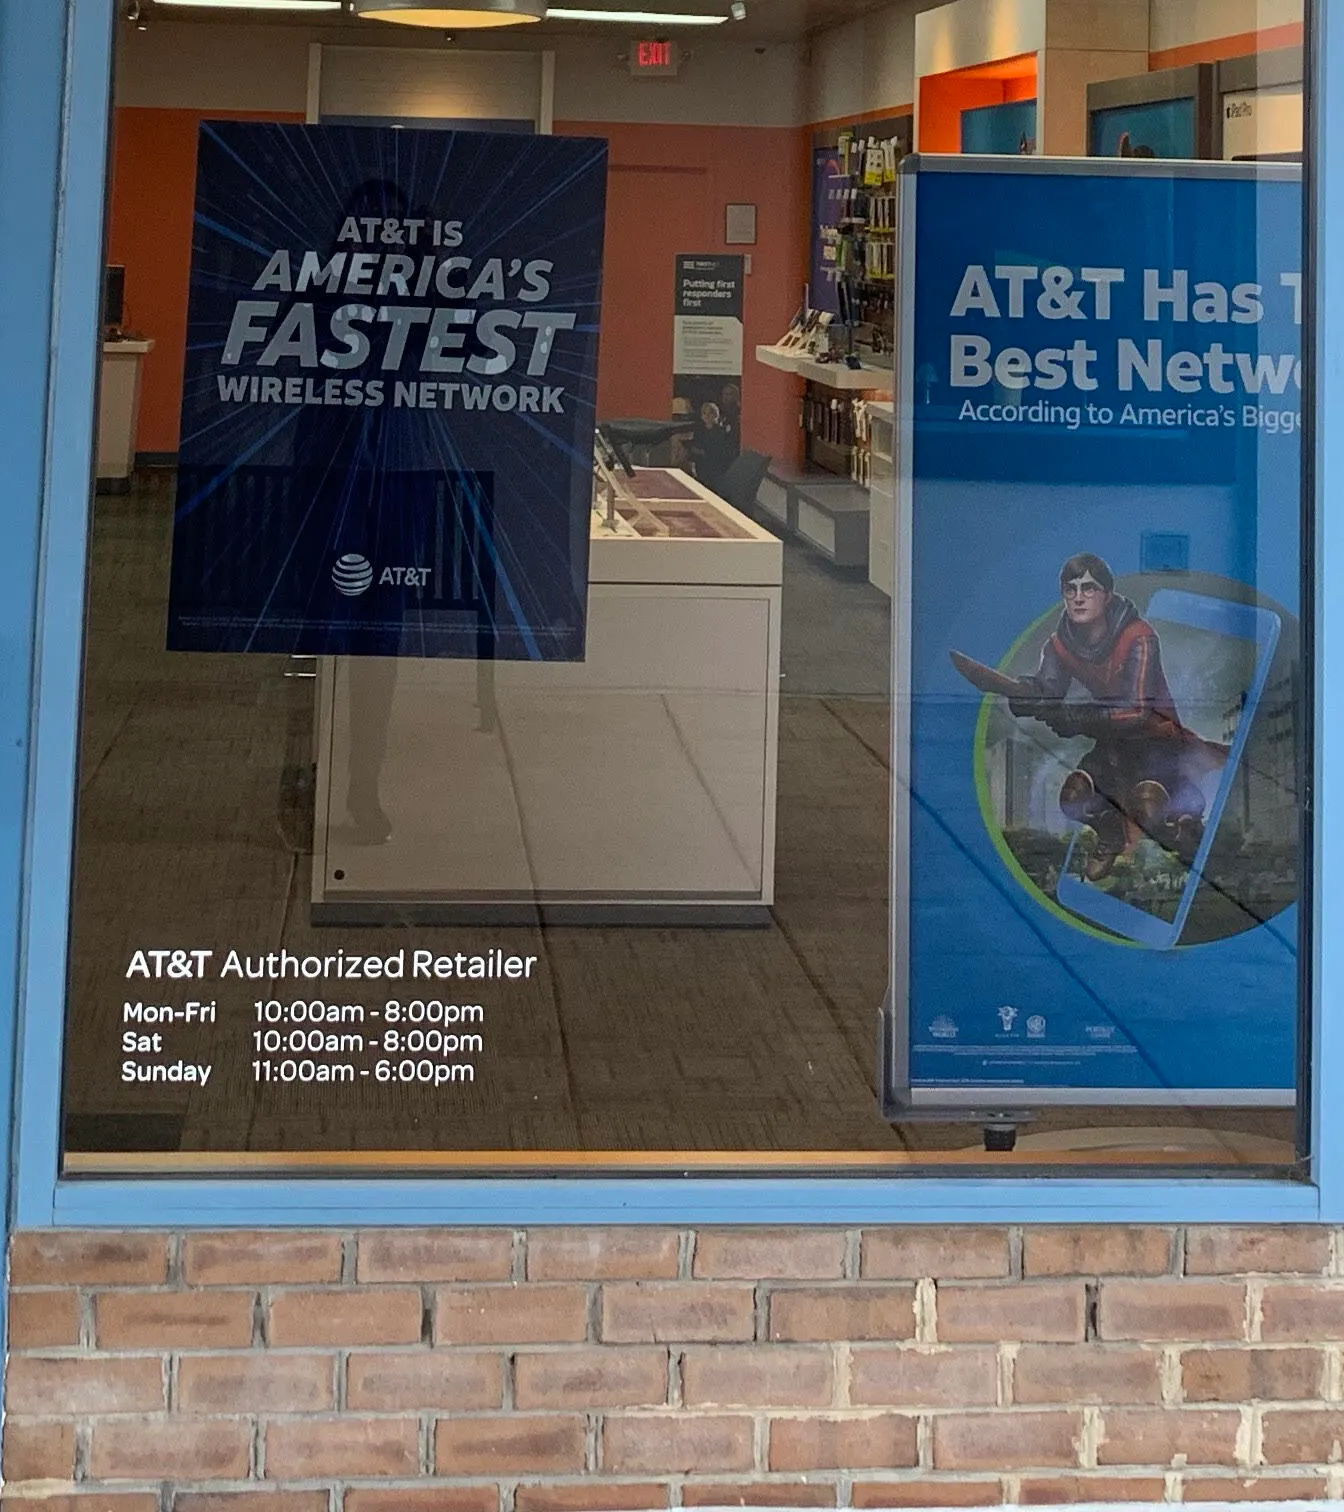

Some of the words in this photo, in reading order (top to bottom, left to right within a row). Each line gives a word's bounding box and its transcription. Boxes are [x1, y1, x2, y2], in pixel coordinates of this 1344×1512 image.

[639, 41, 670, 66] EXIT
[338, 216, 424, 245] AT&T
[433, 219, 463, 246] IS
[252, 250, 554, 302] AMERICA'S
[683, 279, 715, 289] Putting
[717, 280, 736, 289] first
[683, 289, 732, 299] responders
[683, 298, 702, 307] first
[949, 264, 1125, 320] AT&T
[1143, 269, 1265, 324] Has
[220, 301, 577, 376] FASTEST
[950, 335, 1099, 390] Best
[217, 375, 384, 407] WIRELESS
[395, 381, 565, 413] NETWORK
[958, 399, 1081, 430] According
[1085, 402, 1114, 424] to
[1120, 403, 1235, 428] America's
[379, 566, 431, 586] AT&T
[125, 949, 212, 979] AT&T
[220, 949, 404, 979] Authorized
[413, 948, 537, 979] Retailer
[123, 1001, 216, 1023] Mon-Fri
[254, 1000, 364, 1023] 10:00am
[384, 1000, 484, 1027] 8:00pm
[122, 1031, 162, 1052] Sat
[253, 1030, 363, 1053] 10:00am
[383, 1030, 483, 1057] 8:00pm
[121, 1060, 212, 1086] Sunday
[252, 1060, 354, 1083] 11:00am
[374, 1060, 474, 1087] 6:00pm
